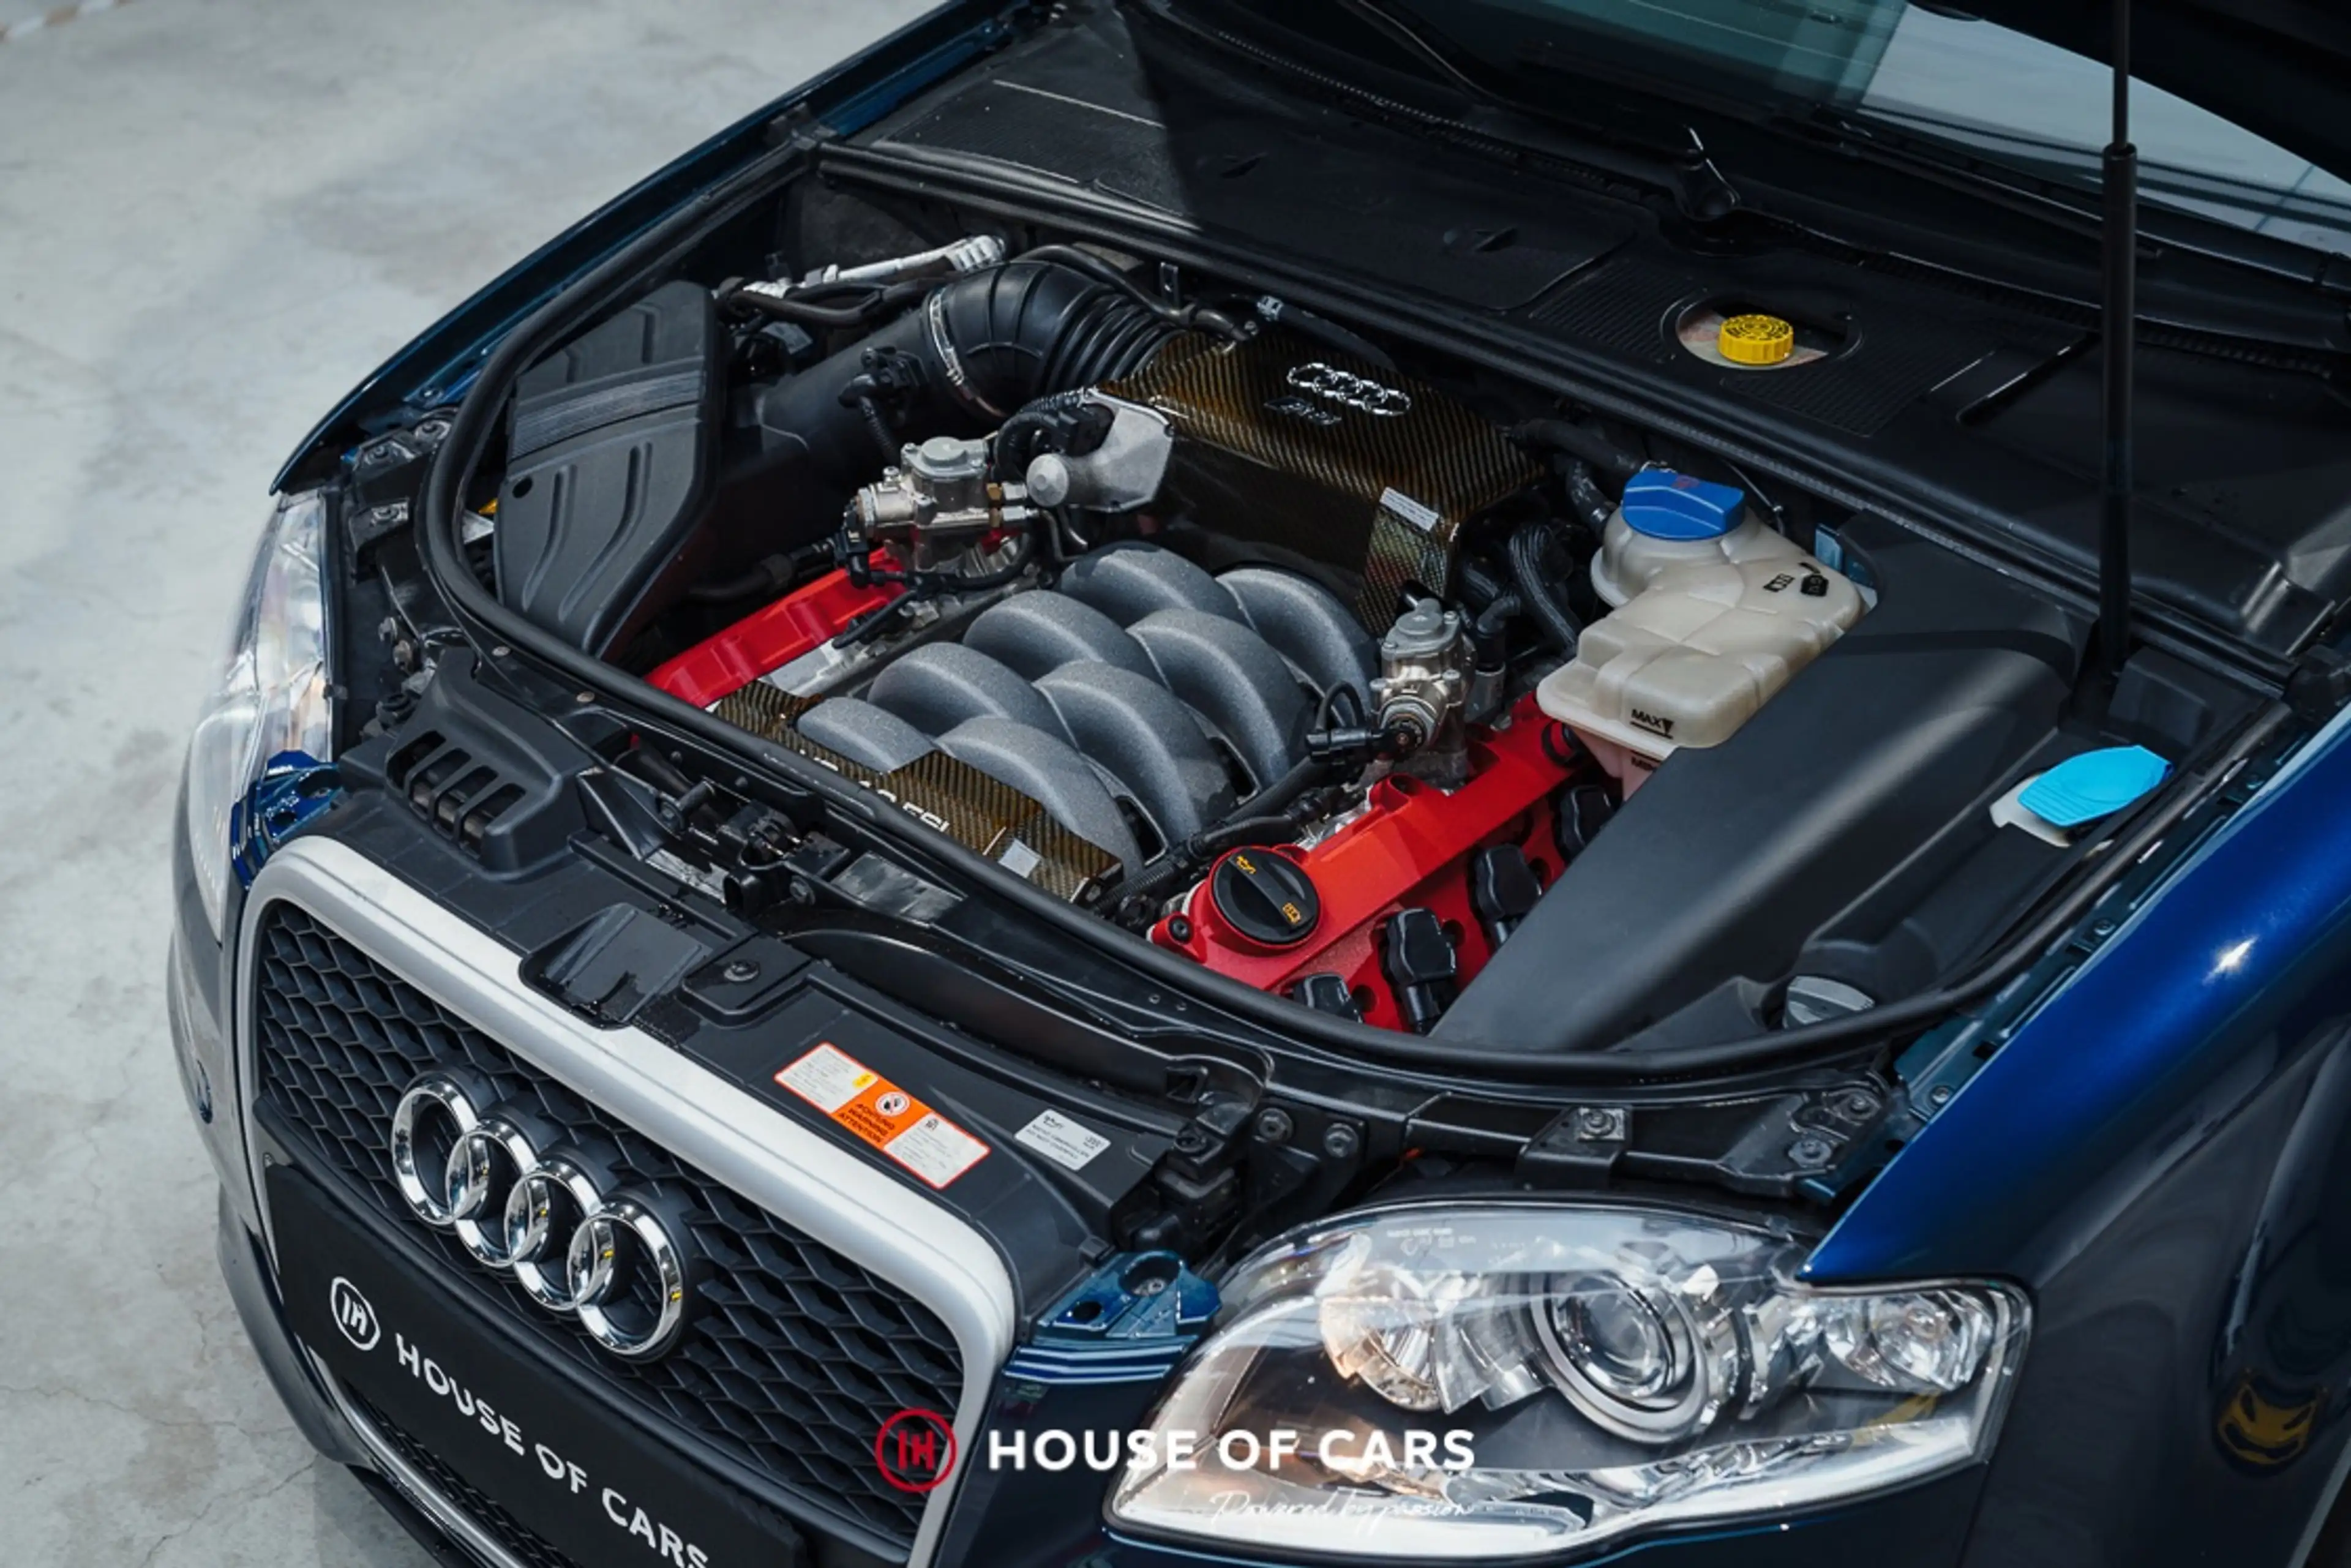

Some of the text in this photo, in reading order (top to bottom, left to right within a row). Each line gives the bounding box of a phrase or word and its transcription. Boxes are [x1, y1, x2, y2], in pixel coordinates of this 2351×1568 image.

[1631, 708, 1661, 729] MAX
[395, 1332, 709, 1568] HOUSE OF CARS
